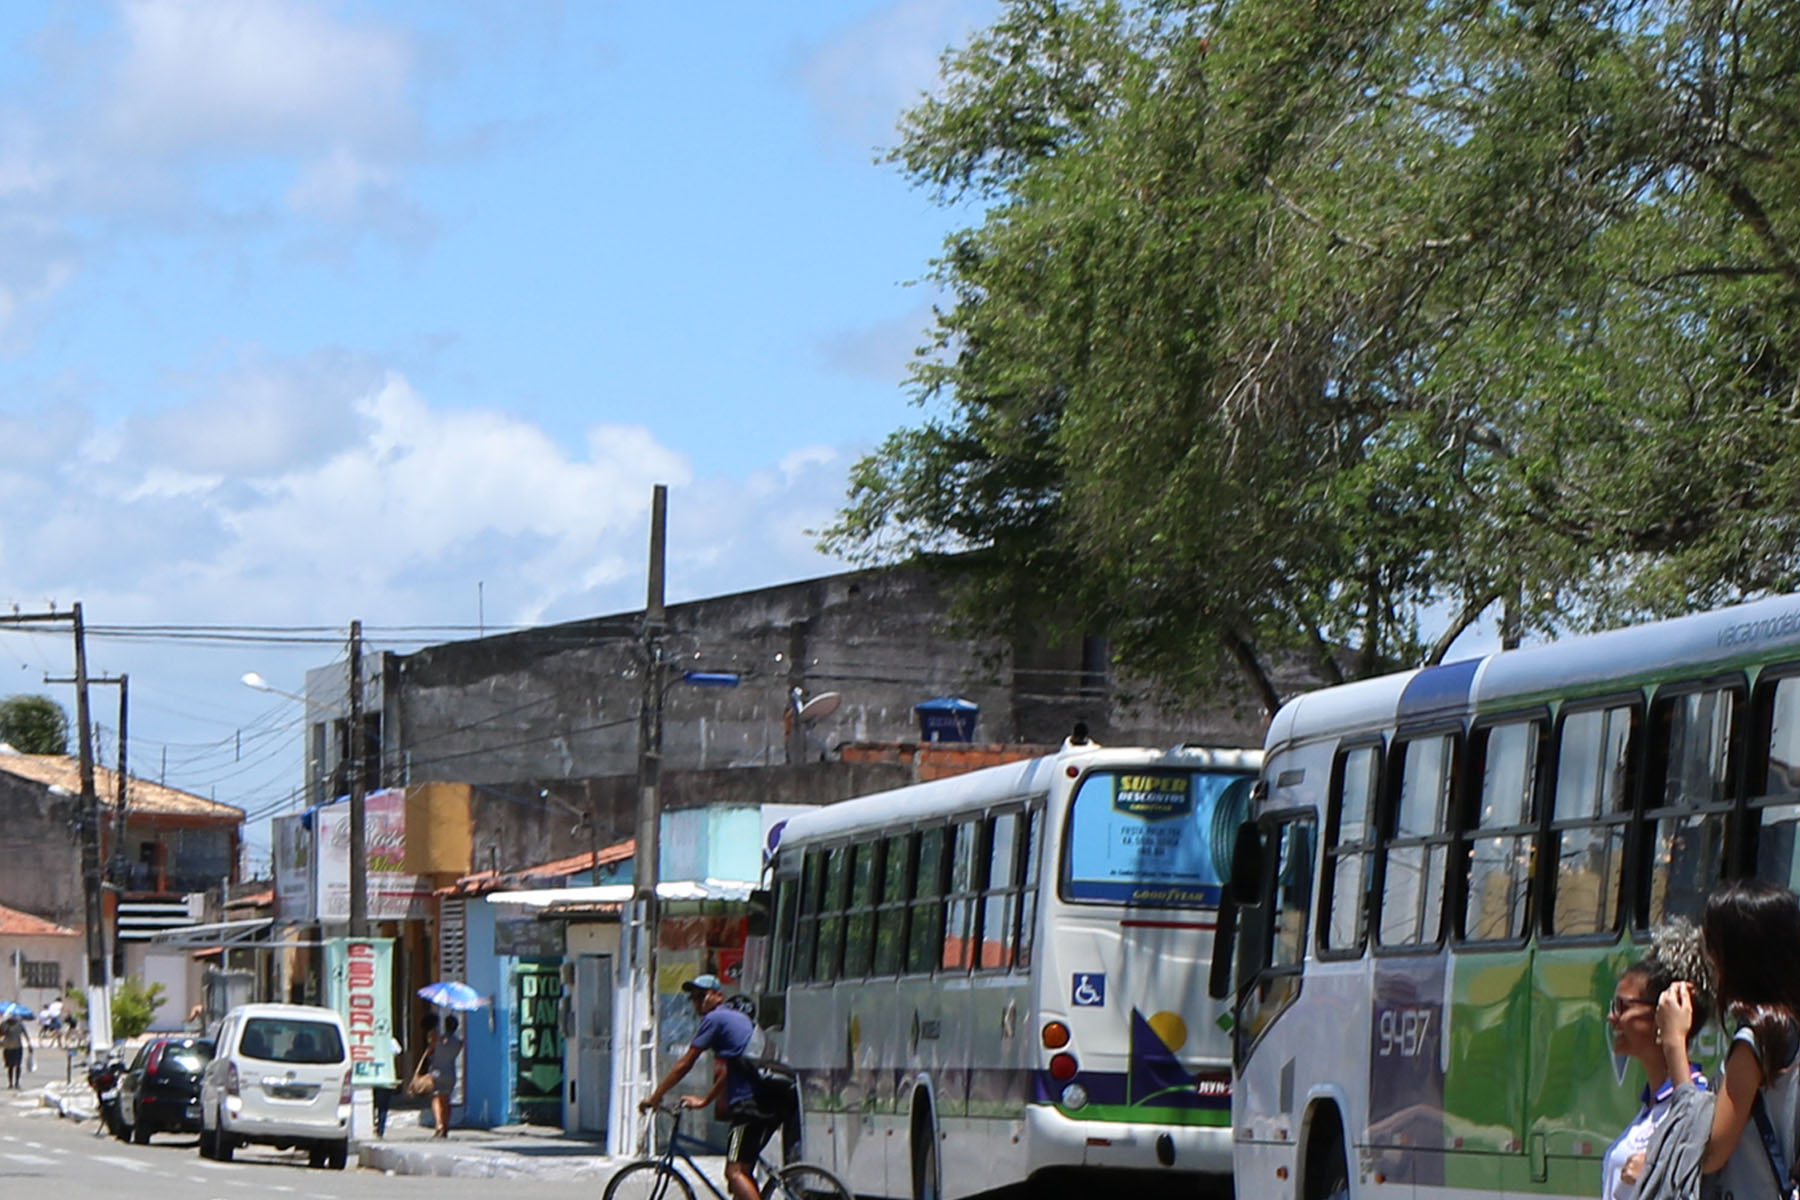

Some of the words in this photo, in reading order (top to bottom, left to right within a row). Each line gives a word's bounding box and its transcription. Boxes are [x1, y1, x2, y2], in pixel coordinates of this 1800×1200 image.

[1119, 775, 1188, 792] SUPER
[1117, 792, 1186, 804] DESCONTOS
[1132, 887, 1204, 900] GOODYEAR
[1379, 1010, 1431, 1056] 9437
